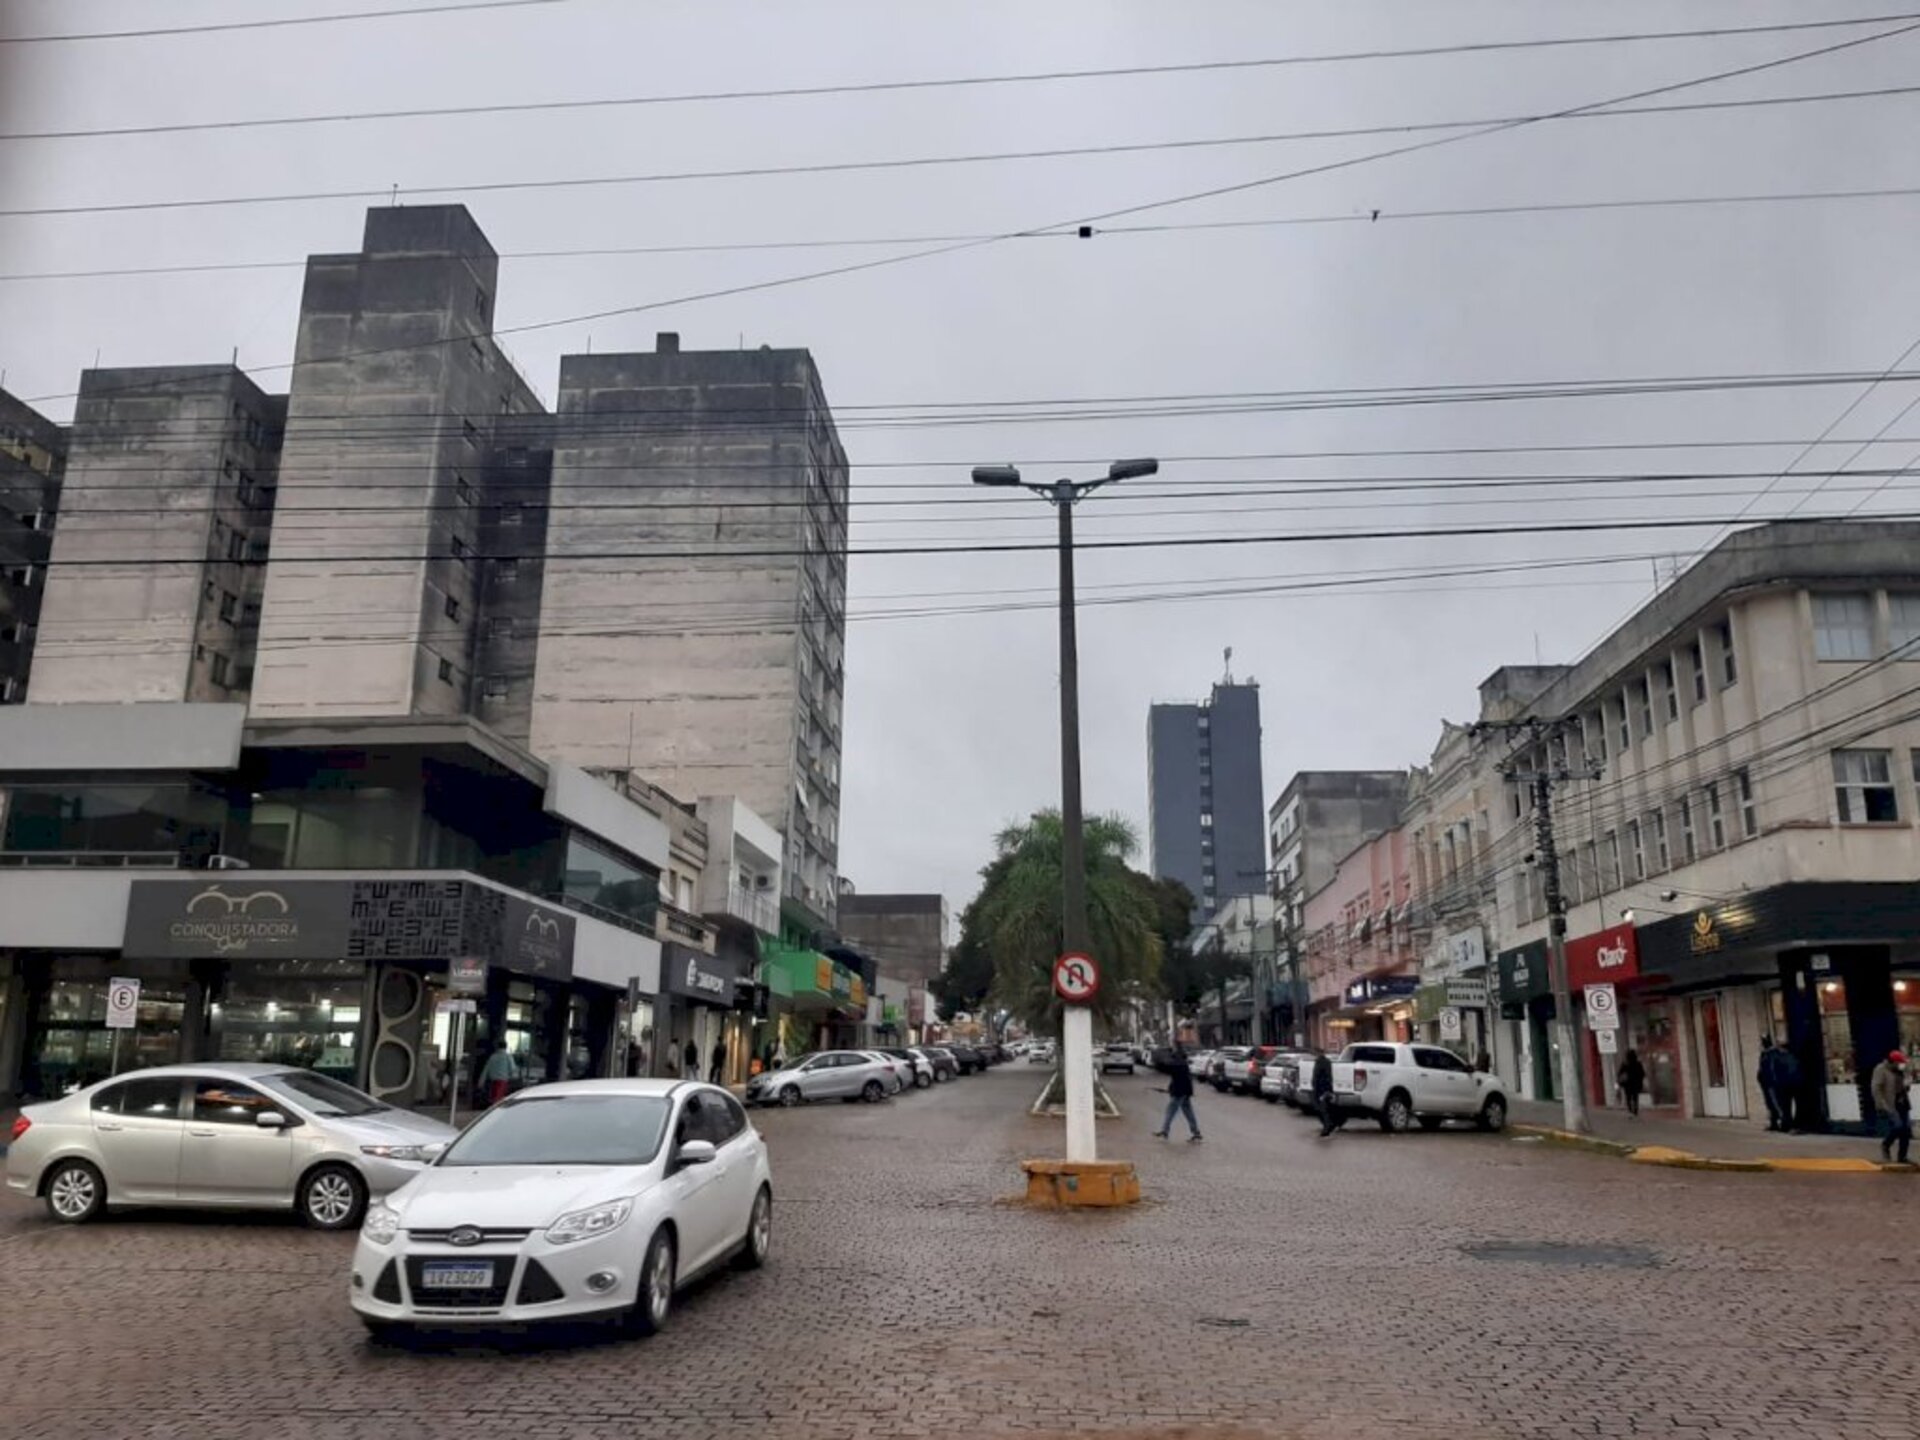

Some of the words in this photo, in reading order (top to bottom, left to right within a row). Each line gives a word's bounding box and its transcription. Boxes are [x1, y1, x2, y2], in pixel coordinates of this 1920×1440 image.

[169, 922, 299, 938] CONQUISTADORA
[1597, 943, 1627, 969] Claro
[119, 991, 129, 1006] E
[1595, 995, 1606, 1008] E
